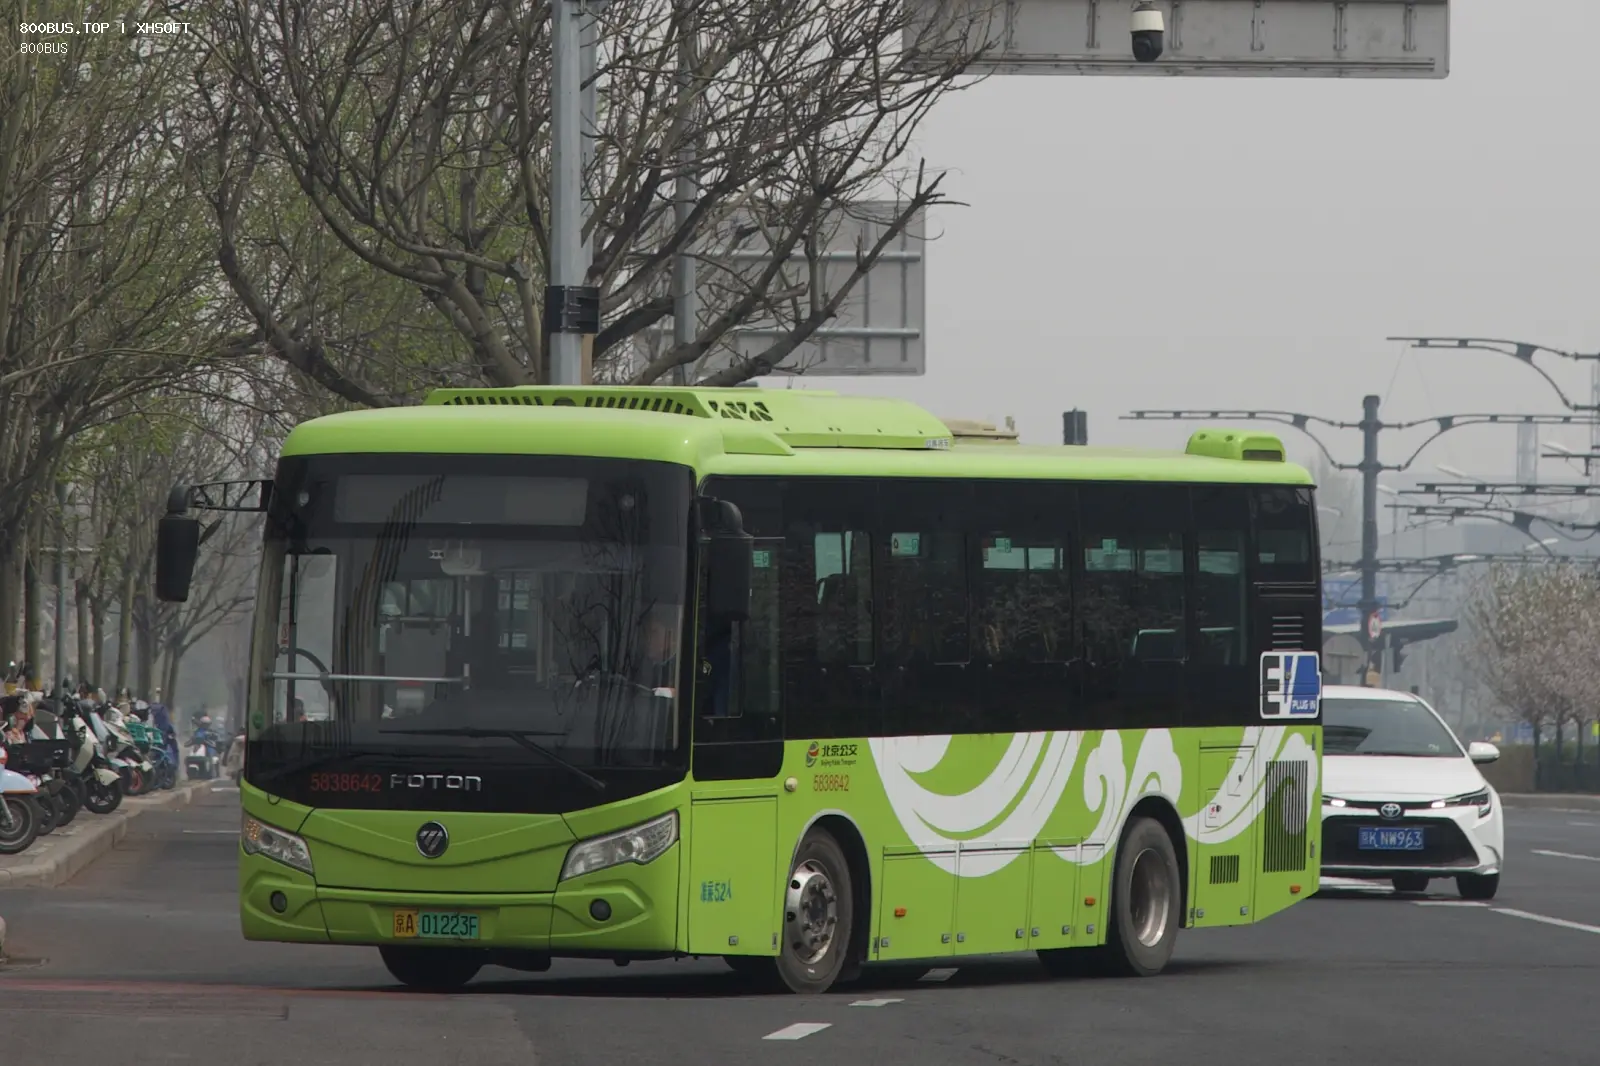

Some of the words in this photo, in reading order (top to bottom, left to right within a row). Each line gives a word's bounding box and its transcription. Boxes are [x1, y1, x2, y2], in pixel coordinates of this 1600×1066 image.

[821, 744, 859, 757] 北京公交
[310, 772, 383, 792] 5838642
[389, 773, 482, 792] FOTON
[813, 774, 850, 792] 5838642
